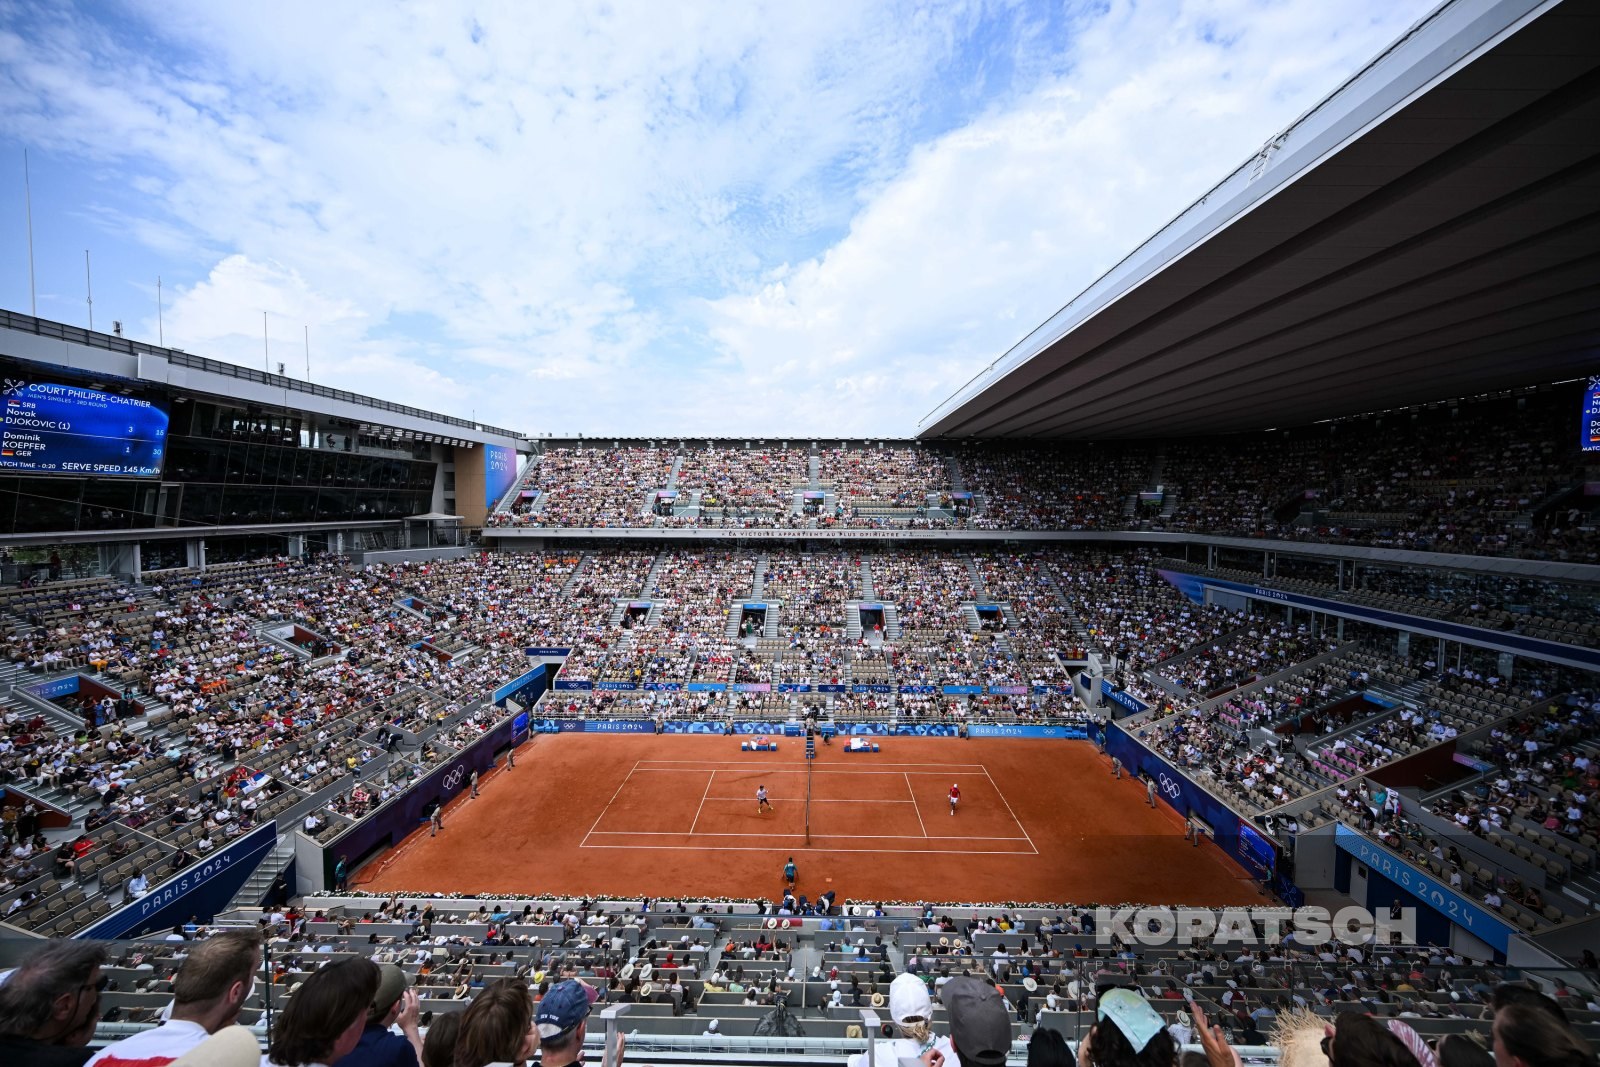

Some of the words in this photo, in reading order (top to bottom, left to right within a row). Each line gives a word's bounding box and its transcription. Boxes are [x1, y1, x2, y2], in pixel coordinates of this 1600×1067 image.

[29, 384, 66, 396] COURT
[68, 390, 151, 408] PHILIPPE-CHATRIER
[6, 408, 36, 417] Novak
[6, 417, 56, 428] DJOKOVIC
[58, 422, 70, 430] (1)
[4, 432, 40, 441] Dominik
[2, 441, 46, 450] KOEPFER
[490, 451, 508, 462] PARIS
[62, 462, 91, 470] SERVE
[94, 464, 120, 472] SPEED
[491, 461, 508, 471] 2024
[1124, 698, 1138, 712] 2024
[142, 880, 188, 915] PARIS
[194, 856, 230, 883] 2024
[1360, 844, 1411, 886] PARIS
[1418, 882, 1472, 926] 2024
